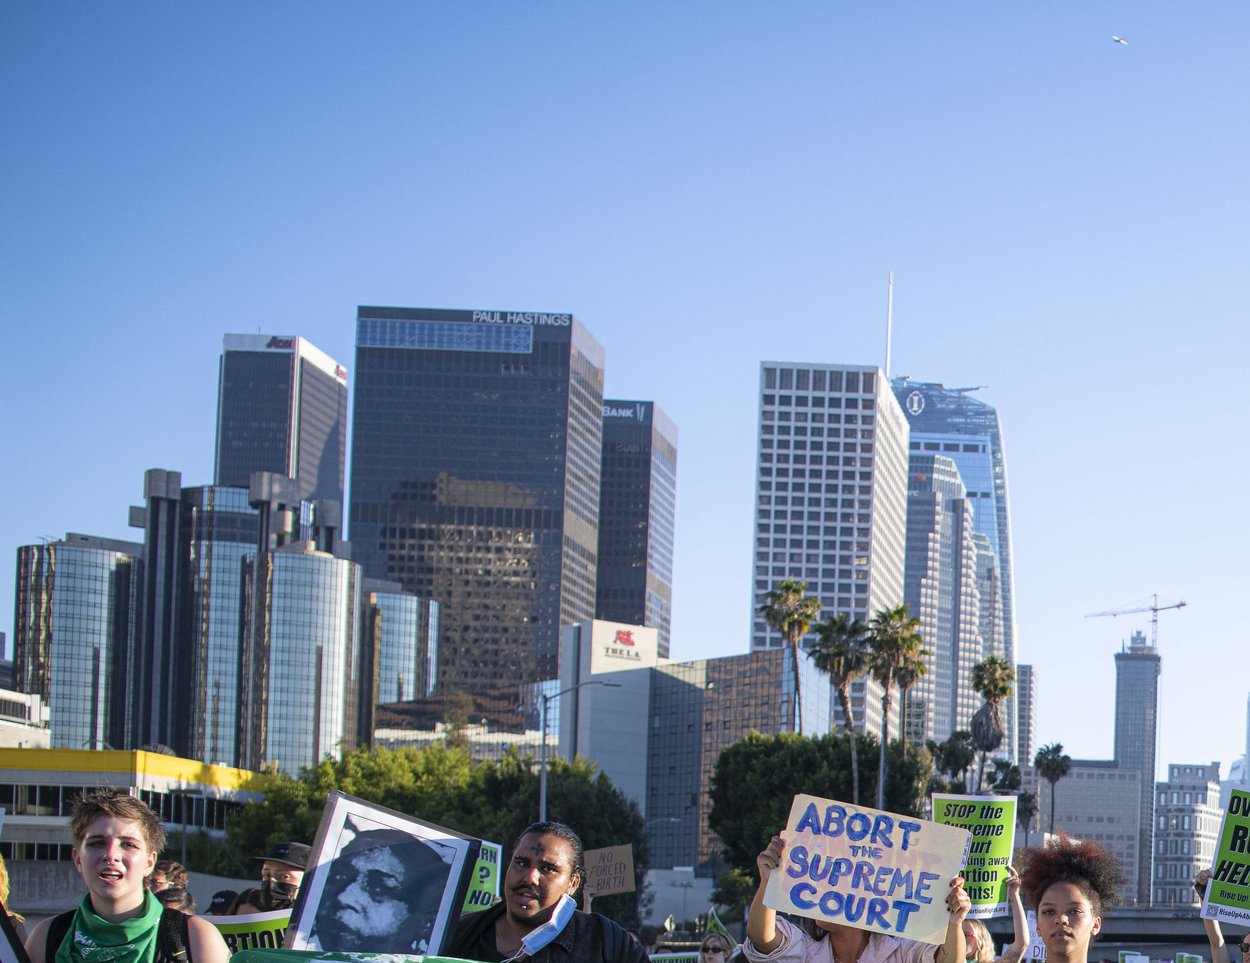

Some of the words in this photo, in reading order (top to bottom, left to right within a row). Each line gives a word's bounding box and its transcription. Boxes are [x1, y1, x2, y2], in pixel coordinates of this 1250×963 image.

[472, 311, 503, 323] PAUL
[507, 313, 570, 326] HASTINGS
[944, 804, 976, 818] STOP
[979, 805, 1003, 819] the
[795, 802, 921, 851] ABORT
[849, 845, 882, 859] THE
[969, 840, 992, 853] urt
[599, 850, 613, 864] NO
[988, 857, 1010, 866] away
[590, 861, 626, 878] FORCED
[786, 846, 940, 904] SUPREME
[960, 868, 997, 882] ortion
[597, 875, 625, 890] BIRTH
[1220, 890, 1235, 900] Rise
[1237, 892, 1248, 902] Up!
[790, 882, 920, 932] COURT
